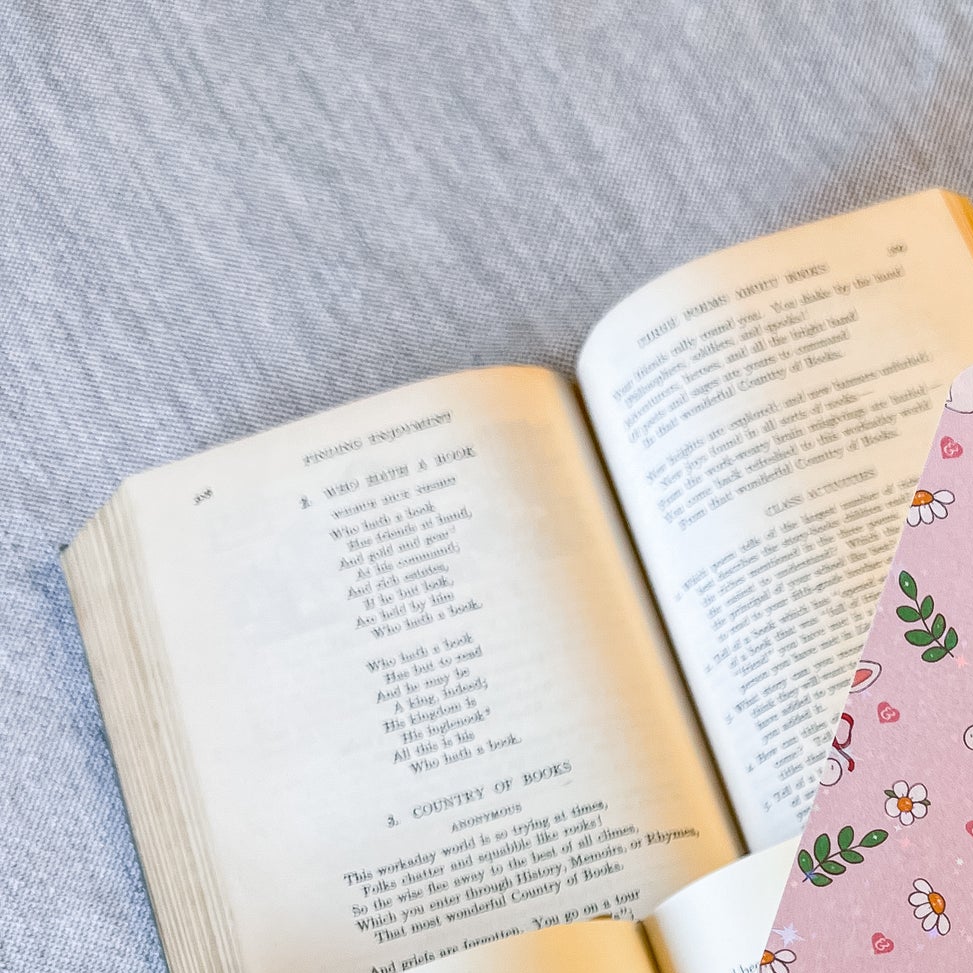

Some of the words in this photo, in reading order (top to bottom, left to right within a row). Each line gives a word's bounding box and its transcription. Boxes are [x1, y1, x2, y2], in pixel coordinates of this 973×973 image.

[412, 786, 485, 820] COUNTRY
[494, 776, 514, 794] OF
[523, 759, 572, 786] BOOKS
[352, 910, 397, 933] Which
[401, 904, 425, 924] you
[429, 893, 461, 912] enter
[464, 875, 513, 901] through
[630, 838, 643, 850] or
[643, 827, 700, 847] Rhymes,
[374, 925, 408, 945] That
[411, 914, 442, 935] most
[444, 890, 507, 923] wonderful
[511, 879, 562, 904] Country
[566, 872, 578, 887] of
